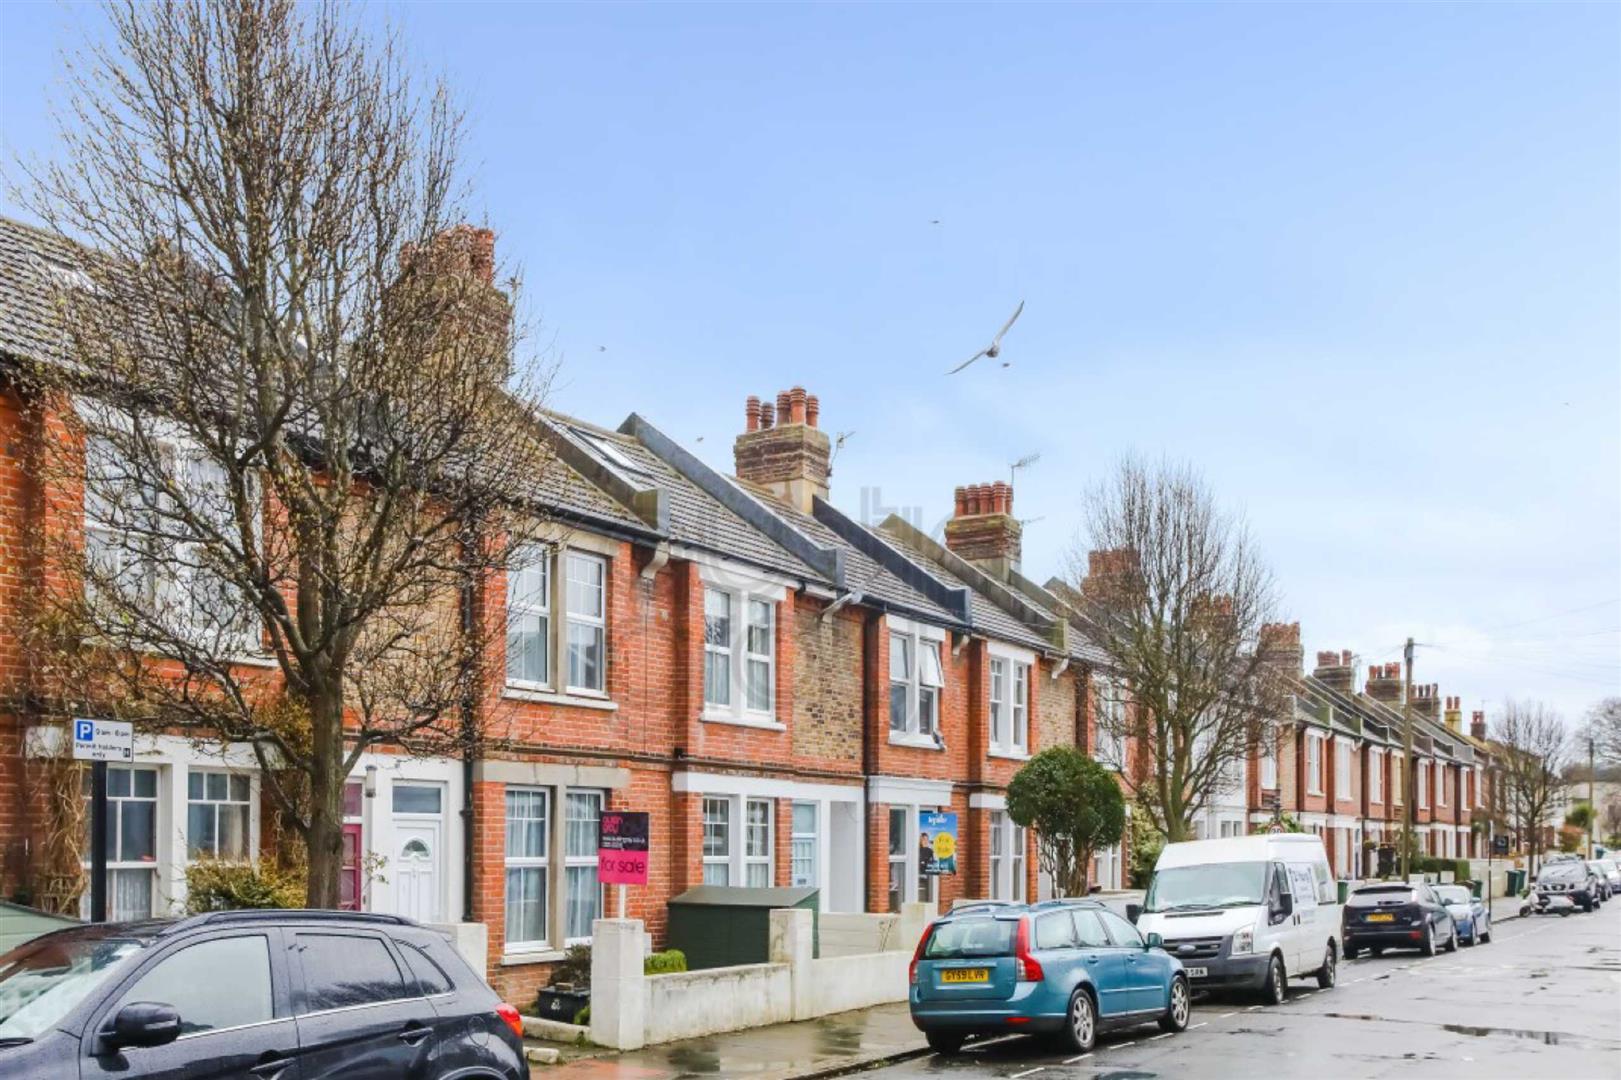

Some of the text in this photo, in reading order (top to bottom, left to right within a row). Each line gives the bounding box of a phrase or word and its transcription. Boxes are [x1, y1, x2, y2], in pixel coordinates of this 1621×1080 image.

[80, 723, 91, 739] P
[600, 856, 646, 874] for sale
